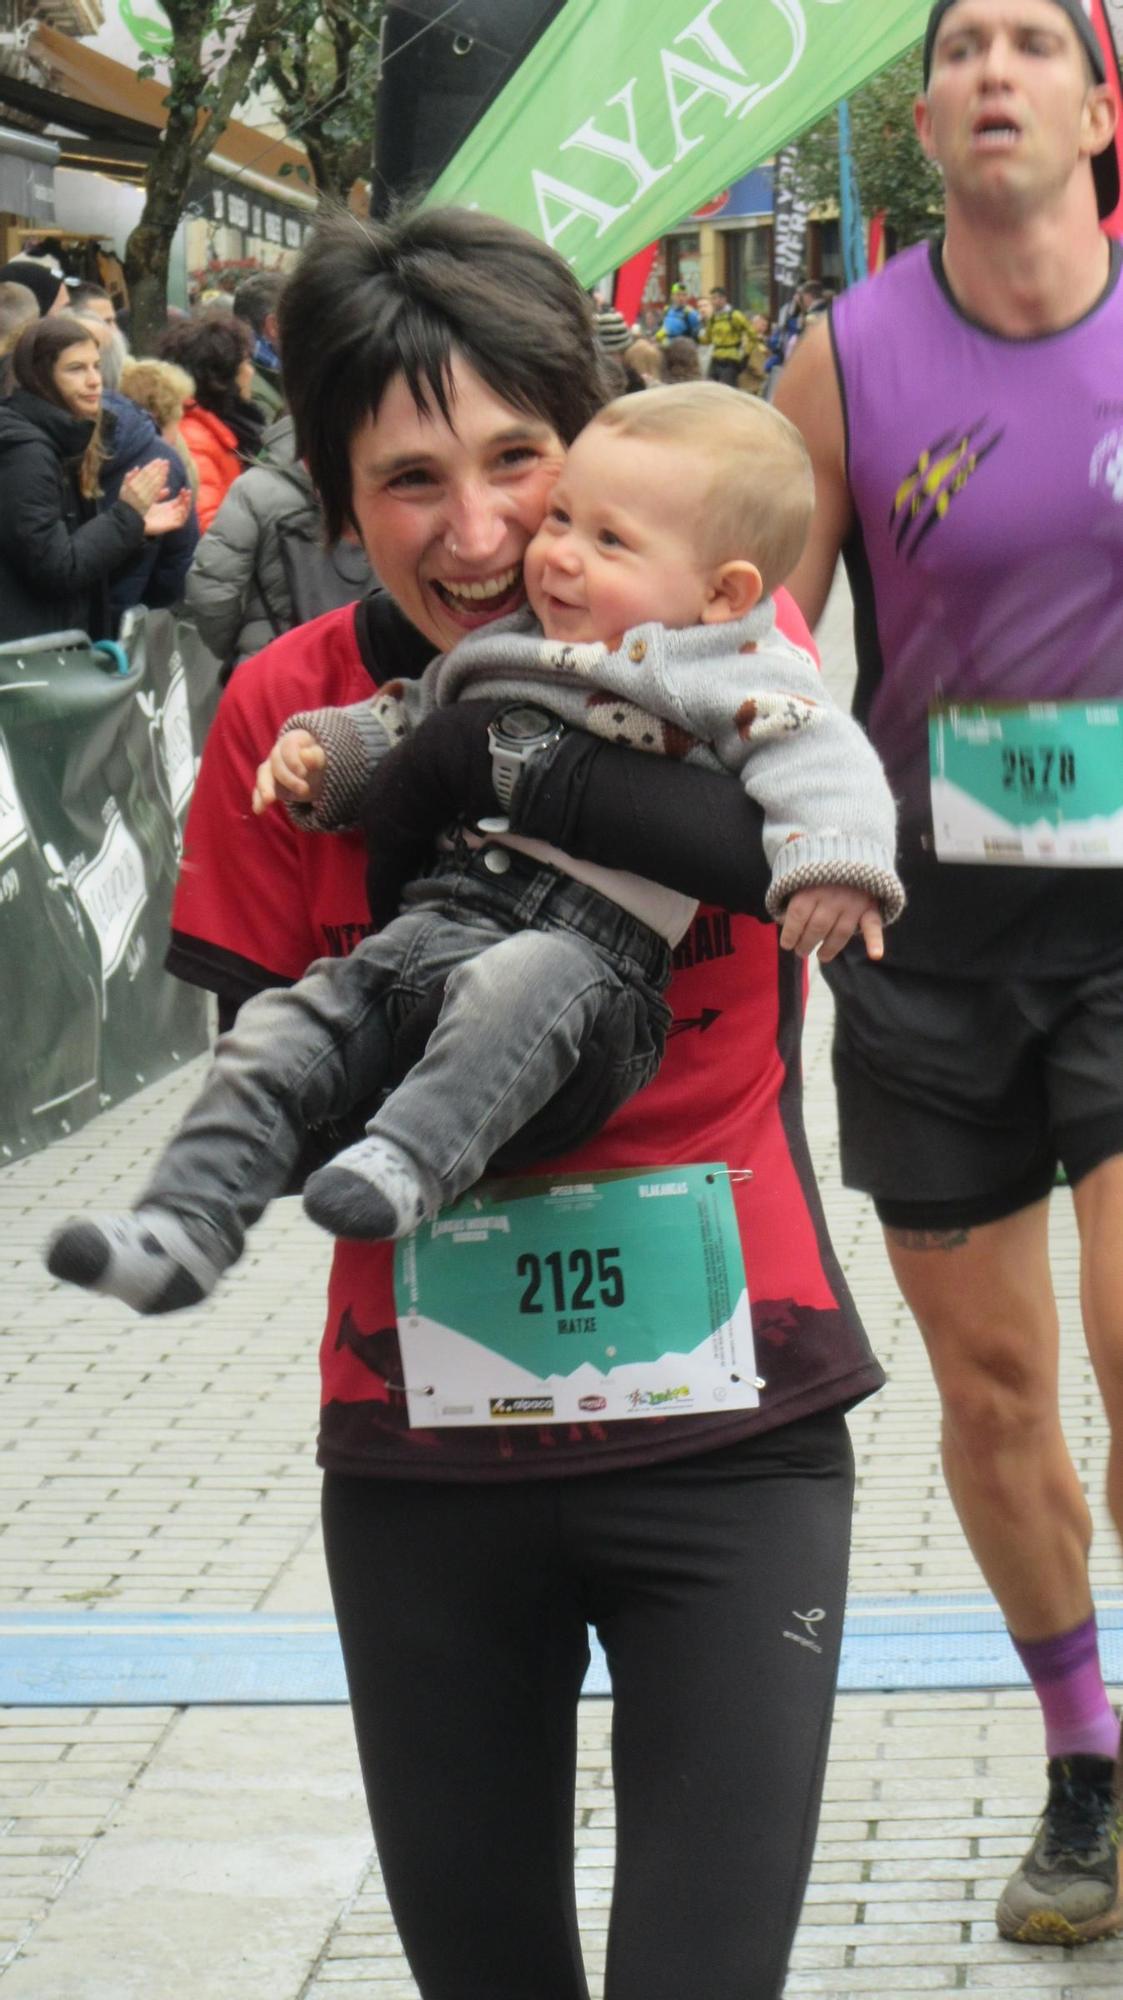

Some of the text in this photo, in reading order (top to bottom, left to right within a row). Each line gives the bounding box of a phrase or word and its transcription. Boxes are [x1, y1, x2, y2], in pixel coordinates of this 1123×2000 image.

[531, 0, 842, 266] AYAD
[516, 1247, 625, 1314] 2125
[557, 1317, 597, 1335] IRATXE
